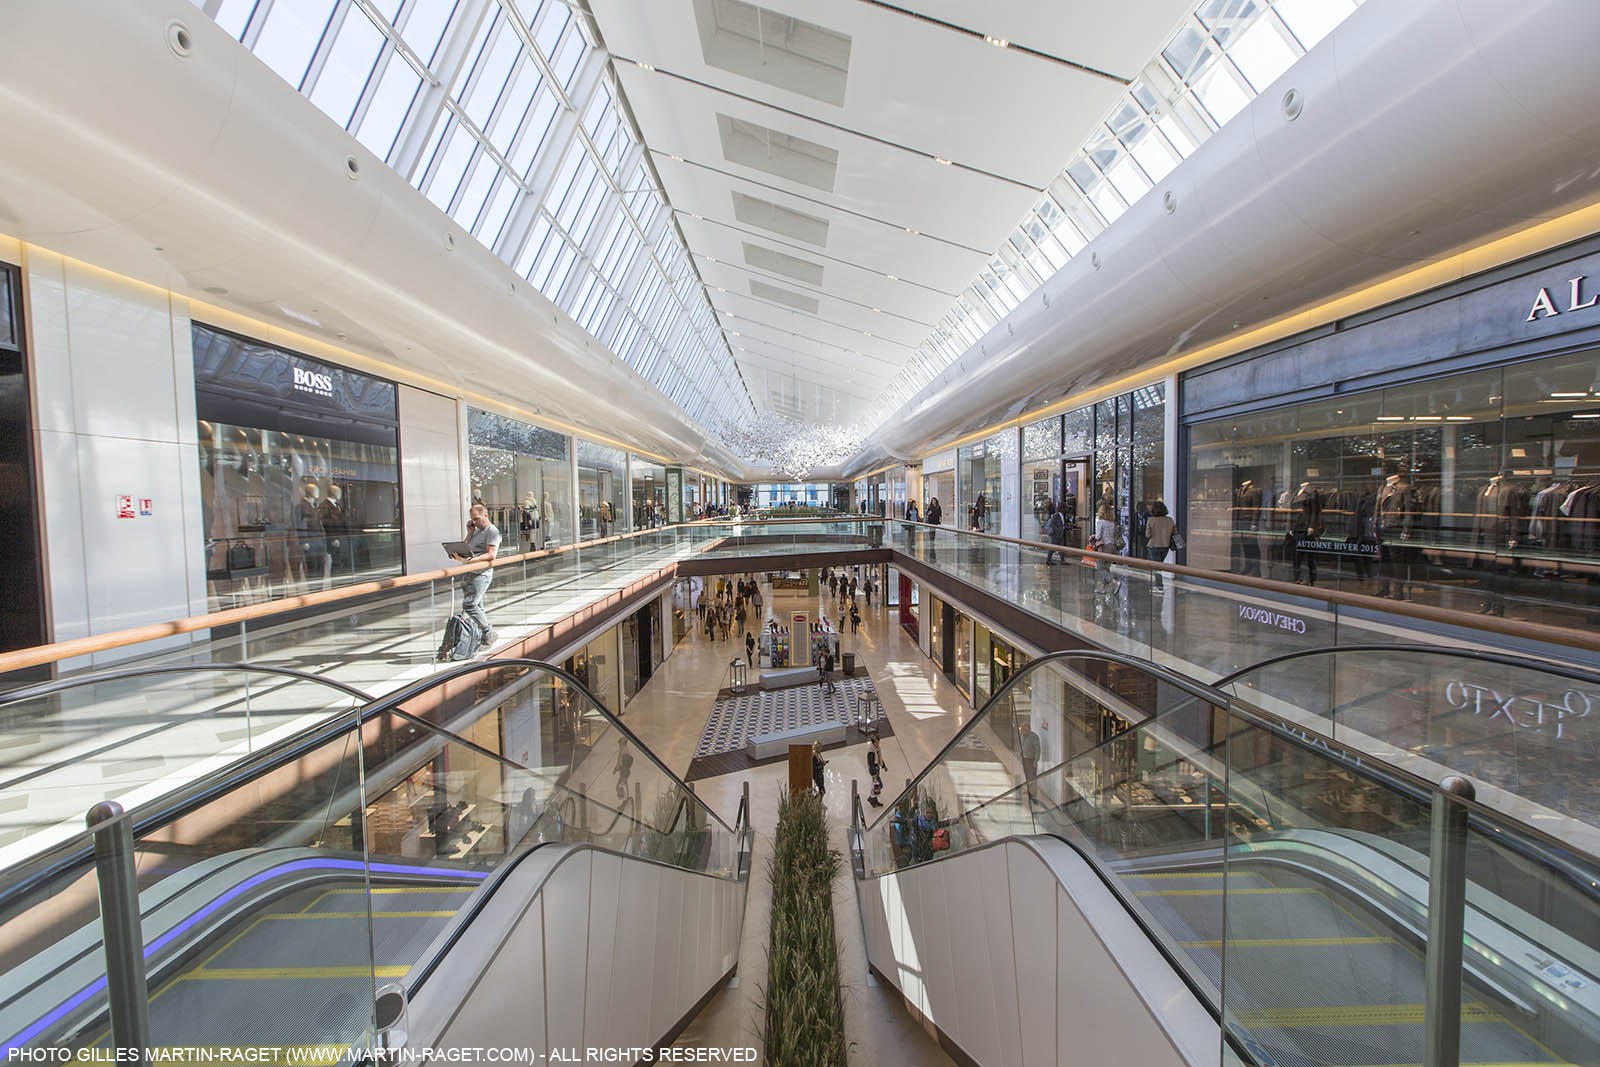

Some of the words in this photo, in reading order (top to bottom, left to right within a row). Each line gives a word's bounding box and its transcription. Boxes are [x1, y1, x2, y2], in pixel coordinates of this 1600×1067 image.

[1525, 276, 1599, 322] AL
[293, 367, 332, 391] BOSS
[1296, 540, 1332, 550] AUTOMNE
[1333, 543, 1359, 552] HIVER
[1361, 544, 1380, 553] 2015
